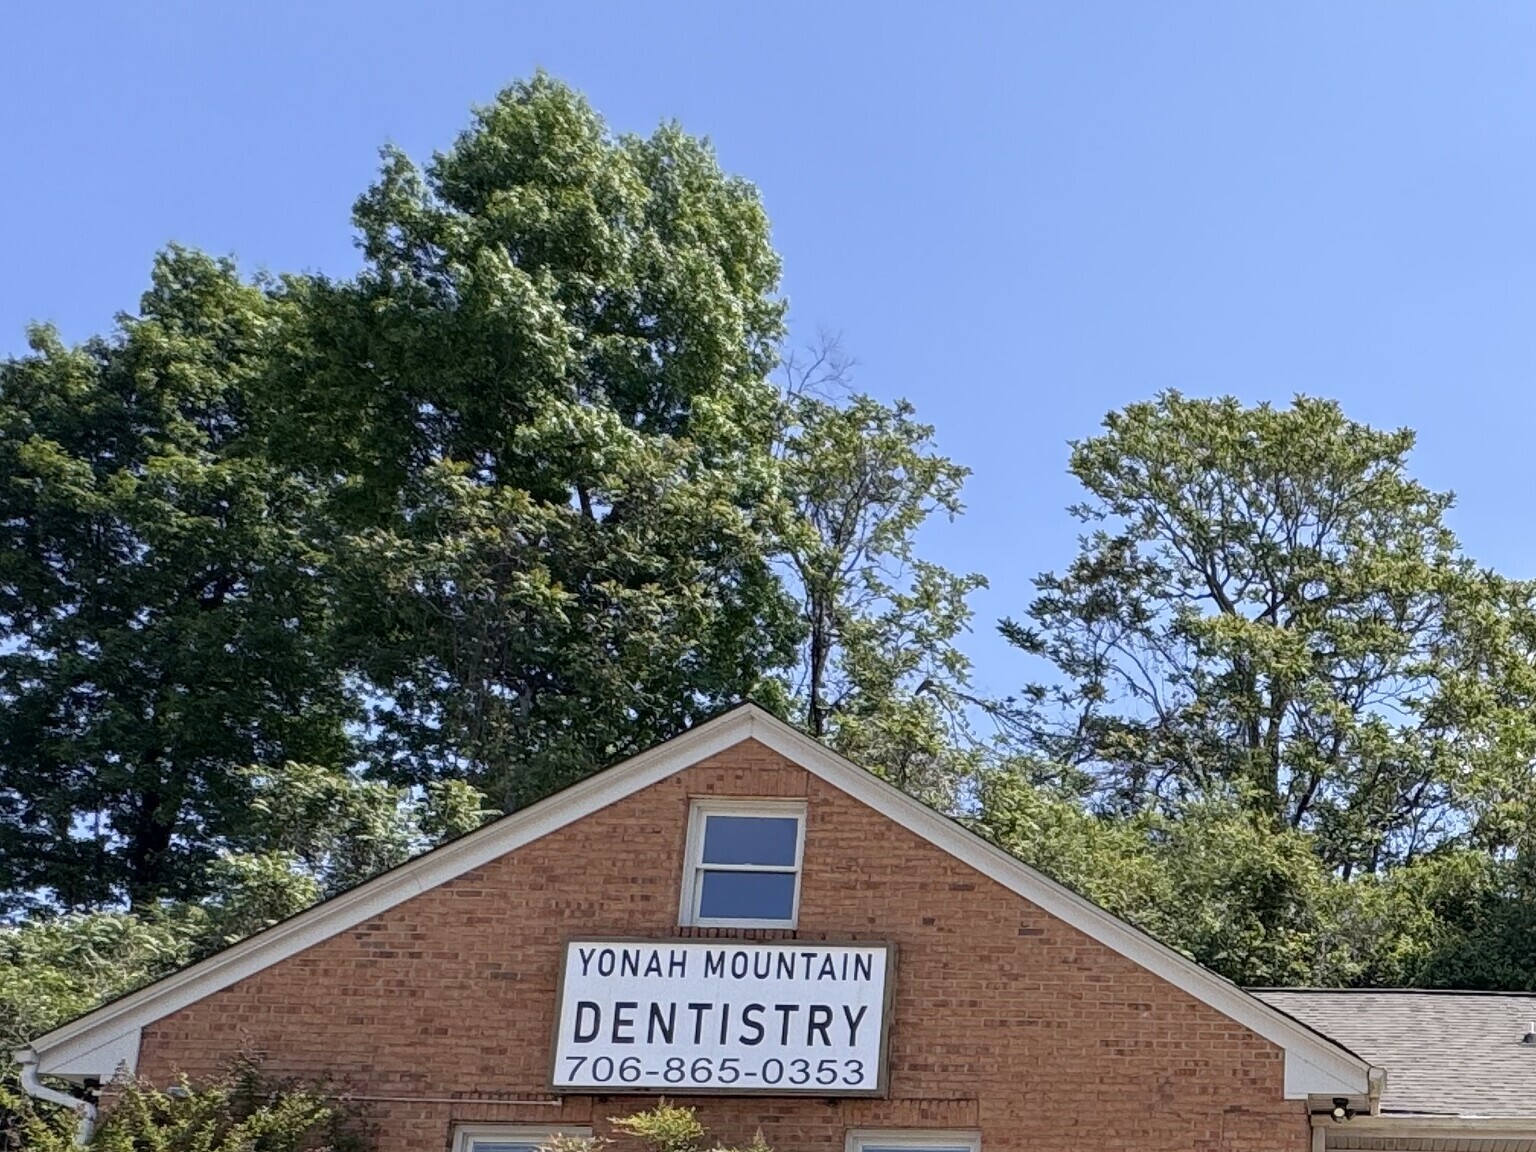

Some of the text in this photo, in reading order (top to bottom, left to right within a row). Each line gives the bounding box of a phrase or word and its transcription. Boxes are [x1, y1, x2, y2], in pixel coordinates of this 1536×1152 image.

[579, 947, 874, 981] YONAH MOUNTAIN
[572, 1000, 868, 1047] DENTISTRY
[564, 1055, 866, 1085] 706-865-0353
